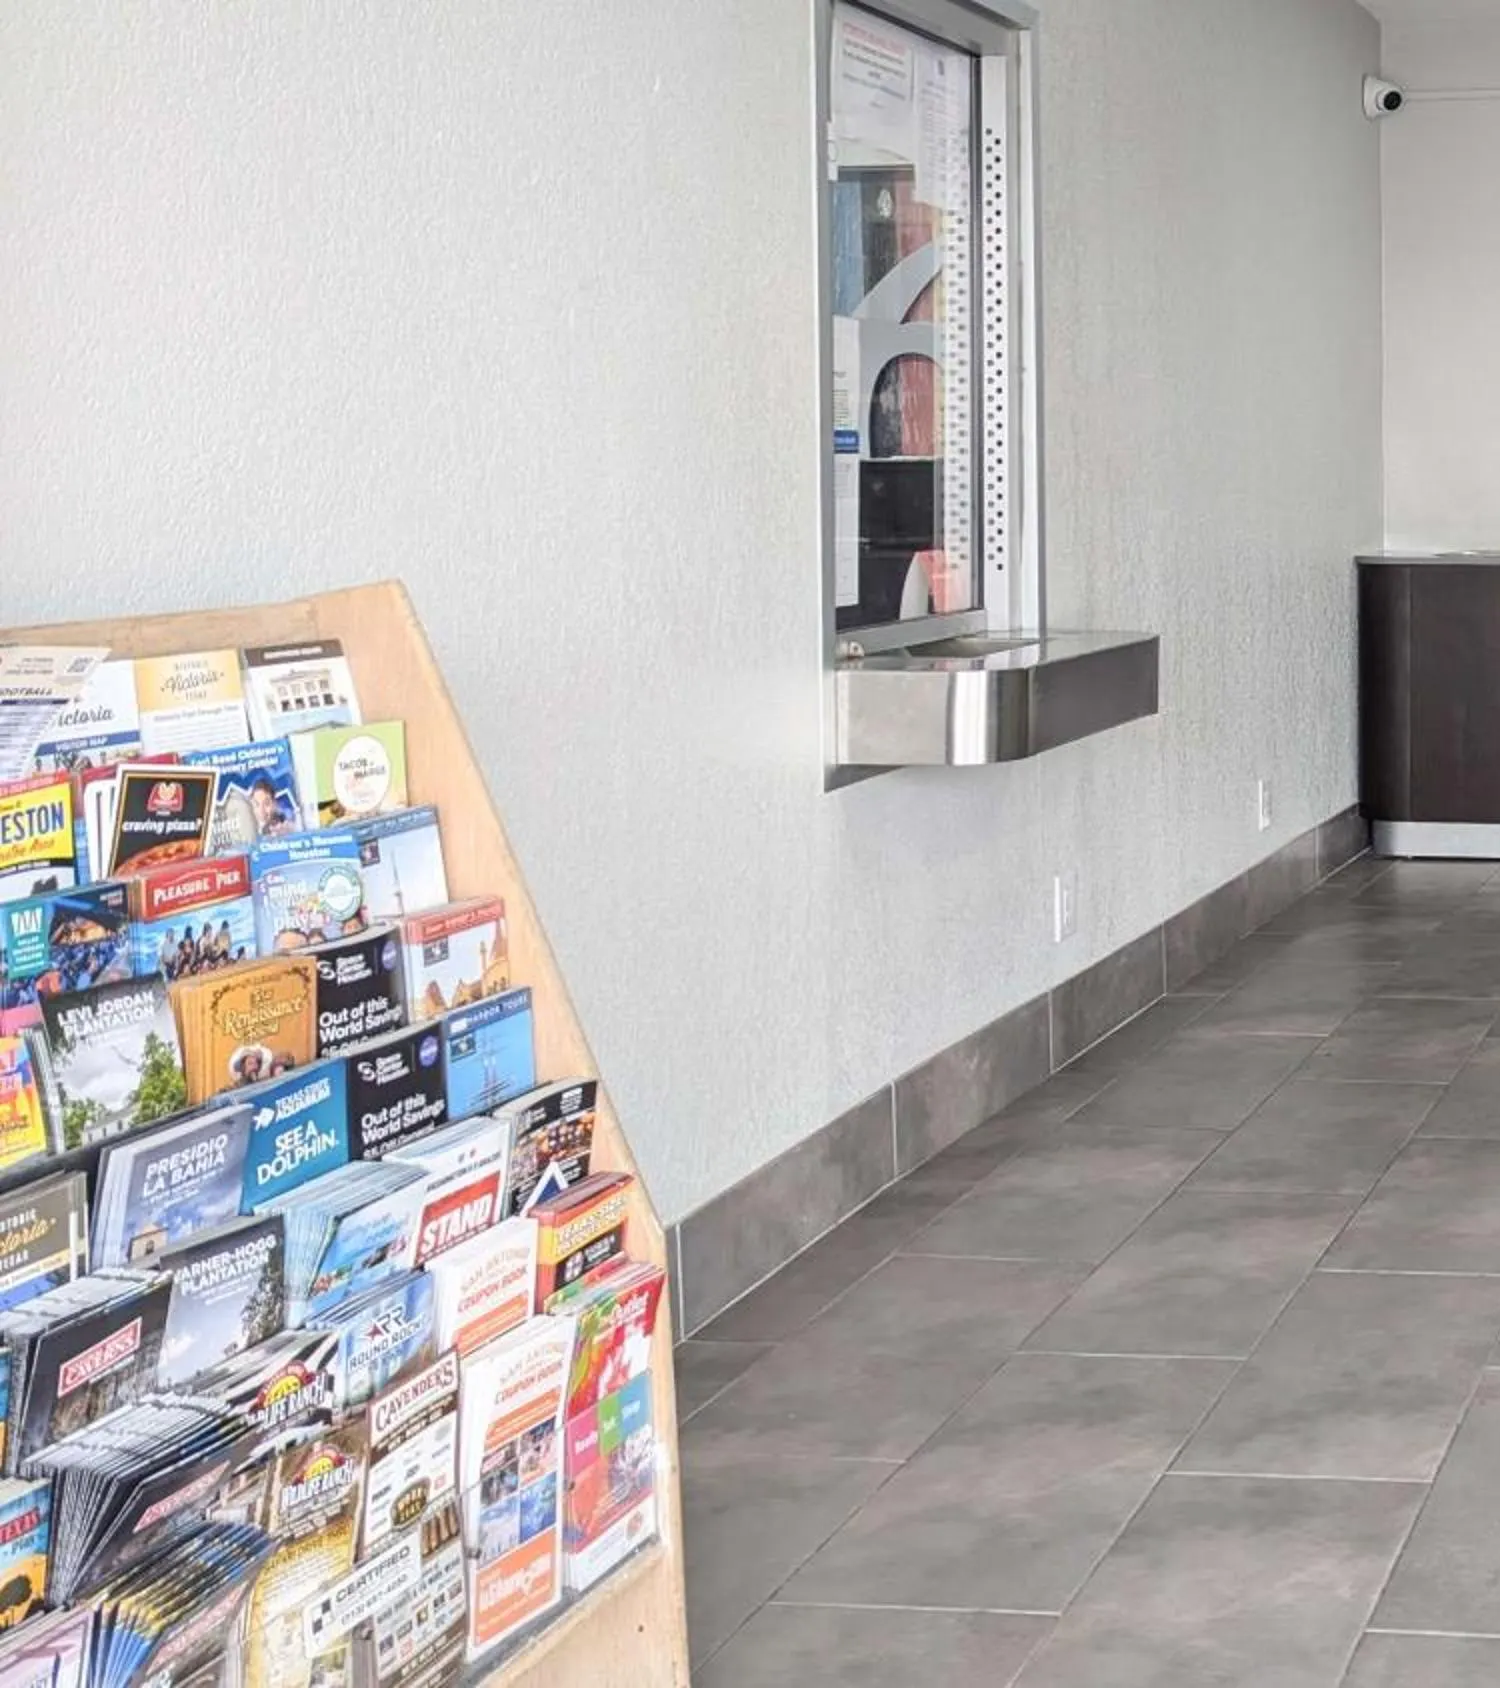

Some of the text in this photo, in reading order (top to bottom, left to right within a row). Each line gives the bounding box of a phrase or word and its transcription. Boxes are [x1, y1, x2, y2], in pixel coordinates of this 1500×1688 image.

[51, 705, 114, 728] ictoria
[121, 817, 204, 834] craving pizza?
[259, 837, 312, 853] Children's
[153, 876, 211, 904] PLEASURE
[215, 868, 242, 891] PIER
[57, 990, 154, 1026] LEVI JORDAN
[63, 1004, 155, 1040] PLANTATION
[319, 995, 389, 1029] Out of this
[319, 1020, 364, 1043] World
[361, 1092, 427, 1129] Out of this
[362, 1099, 446, 1145] World Savings
[275, 1119, 321, 1153] SEE A
[146, 1132, 229, 1181] PRESIDIO
[143, 1177, 166, 1199] LA
[421, 1192, 494, 1252] STAND
[172, 1233, 278, 1285] VARNER-HOGG
[181, 1251, 270, 1296] PLANTATION
[348, 1336, 389, 1371] ROUND
[335, 1545, 411, 1603] CERTIFIED
